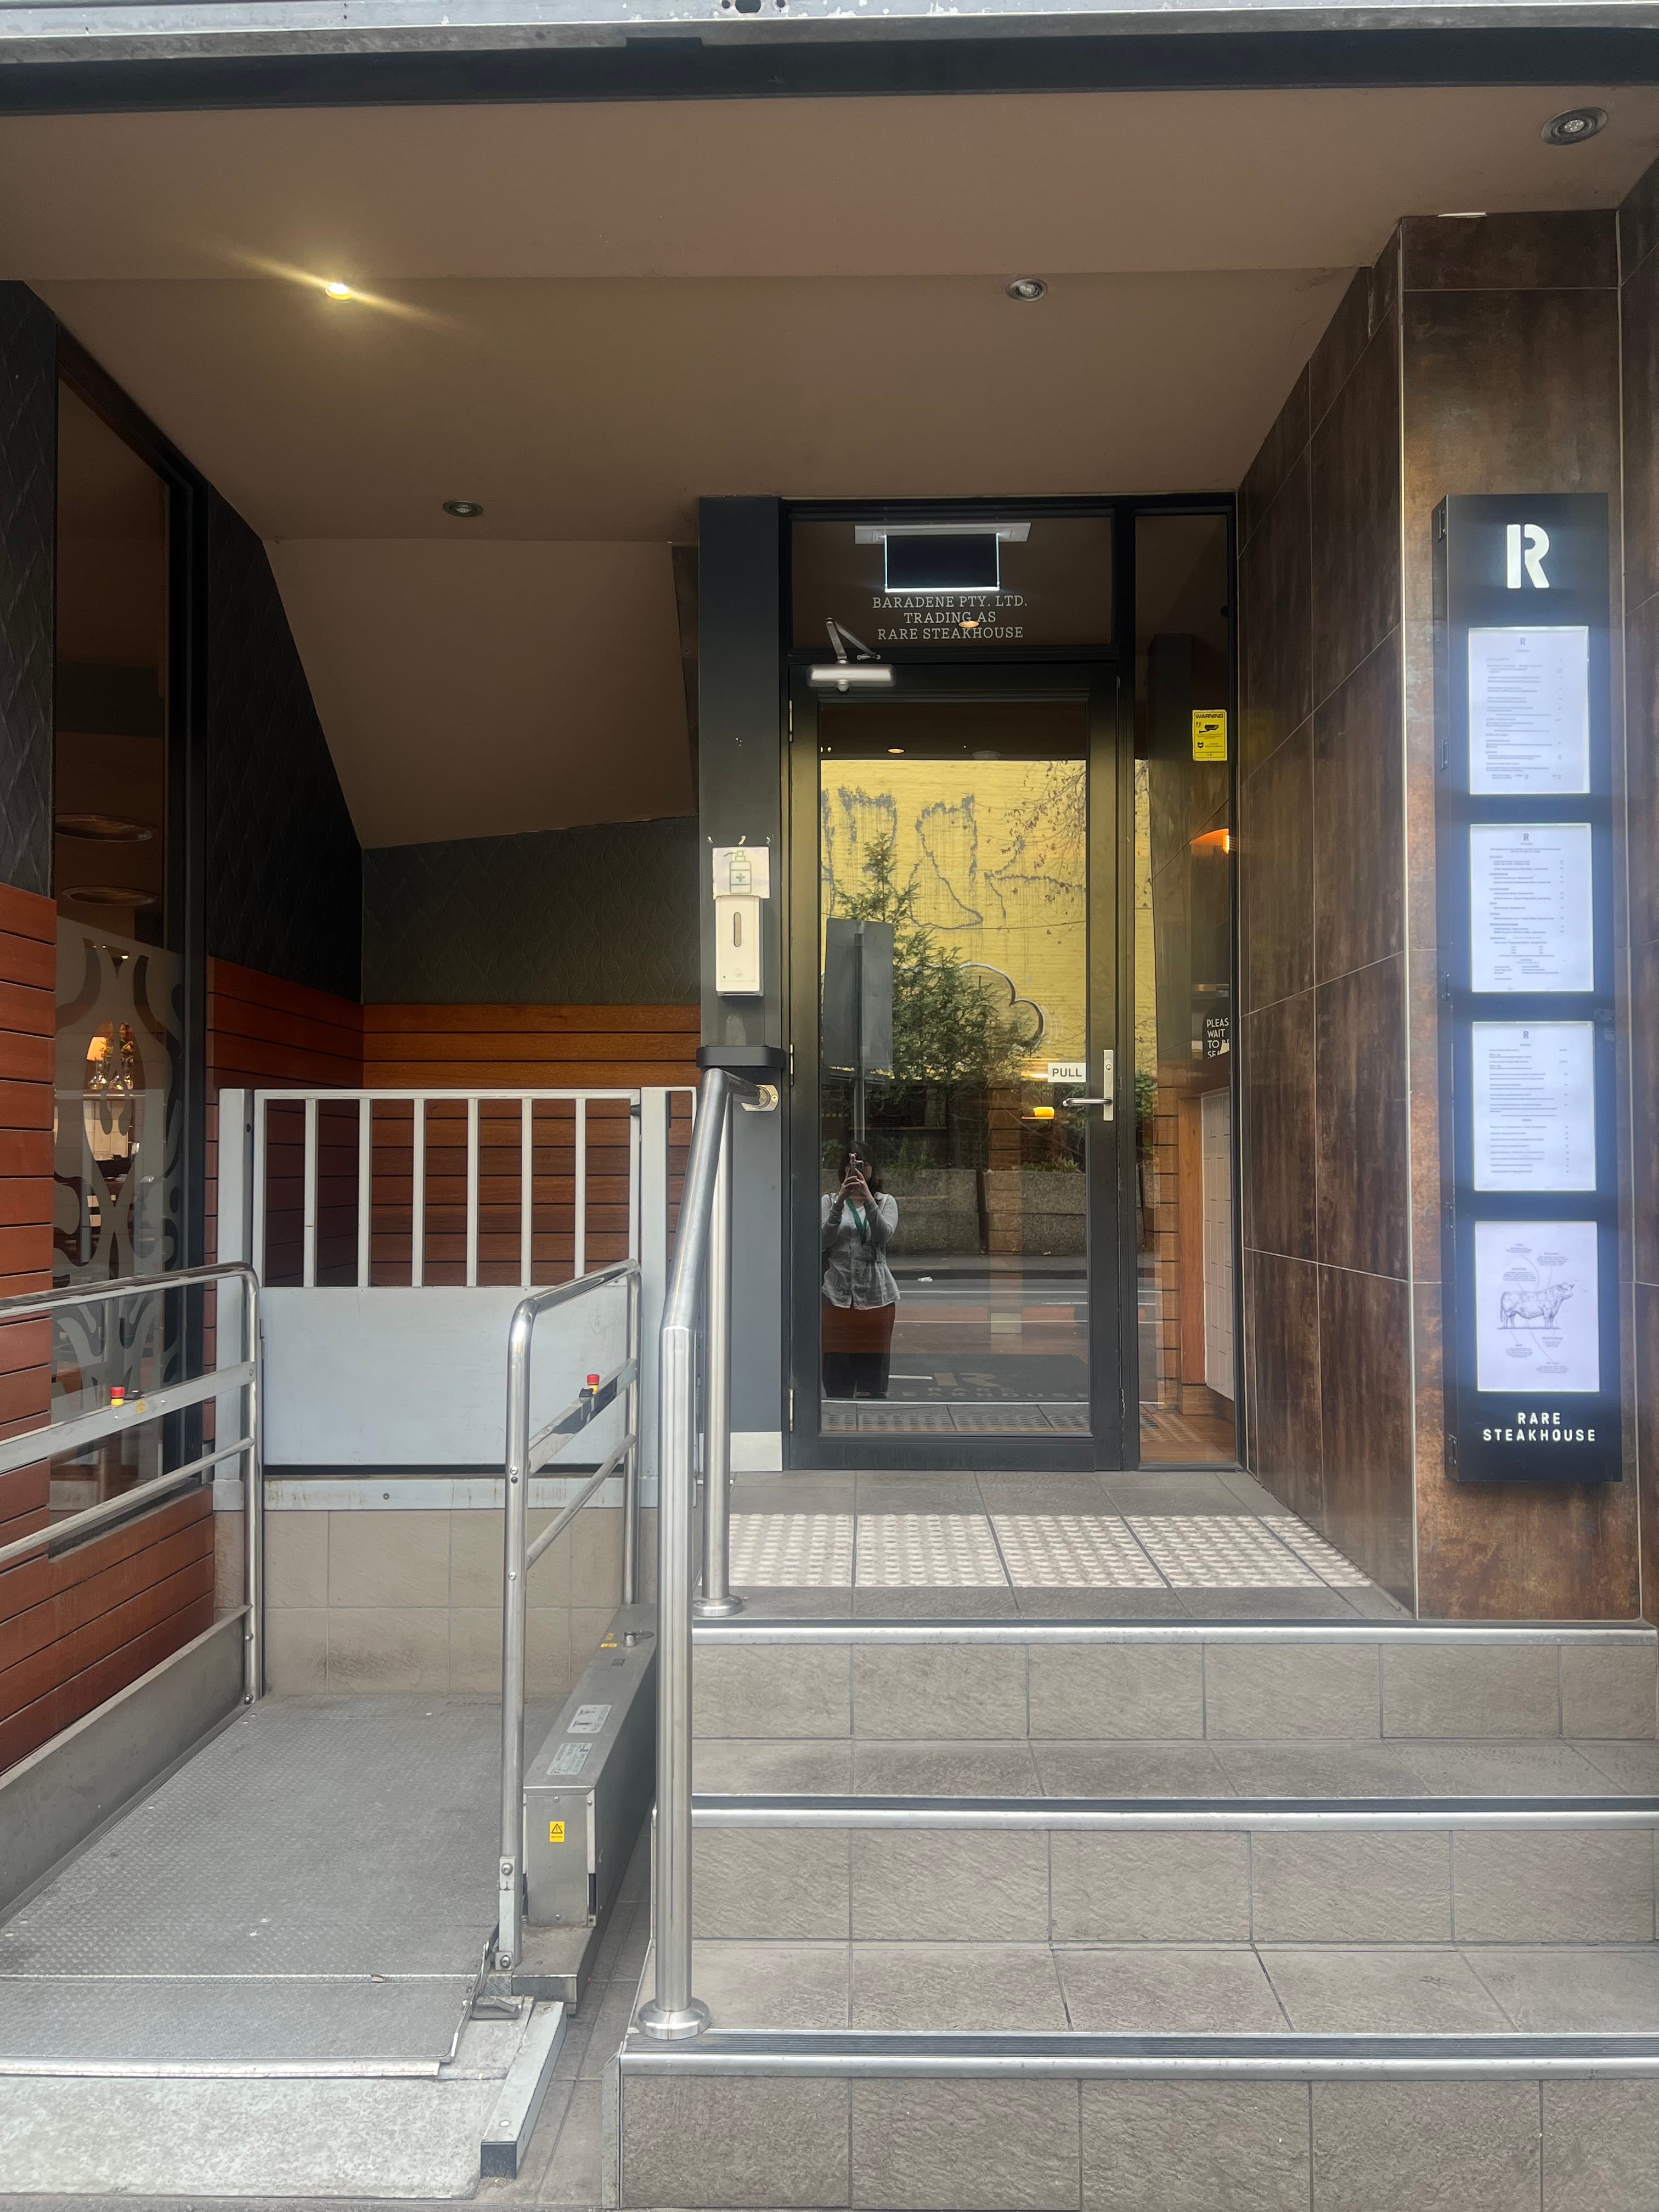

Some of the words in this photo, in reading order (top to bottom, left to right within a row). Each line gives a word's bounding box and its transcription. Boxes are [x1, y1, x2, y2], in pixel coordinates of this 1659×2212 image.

[1507, 524, 1550, 588] R
[872, 596, 955, 608] BARADENE
[959, 596, 991, 607] PTY.
[995, 595, 1028, 606] LTD.
[904, 612, 972, 624] TRADING
[977, 611, 996, 623] AS
[878, 628, 918, 640] RARE
[923, 627, 1023, 640] STEAKHOUSE
[1207, 1029, 1226, 1039] WAIT
[1207, 1040, 1220, 1049] TO
[1052, 1068, 1082, 1077] PULL
[1517, 1412, 1561, 1425] RARE
[1483, 1429, 1596, 1442] STEAKHOUSE
